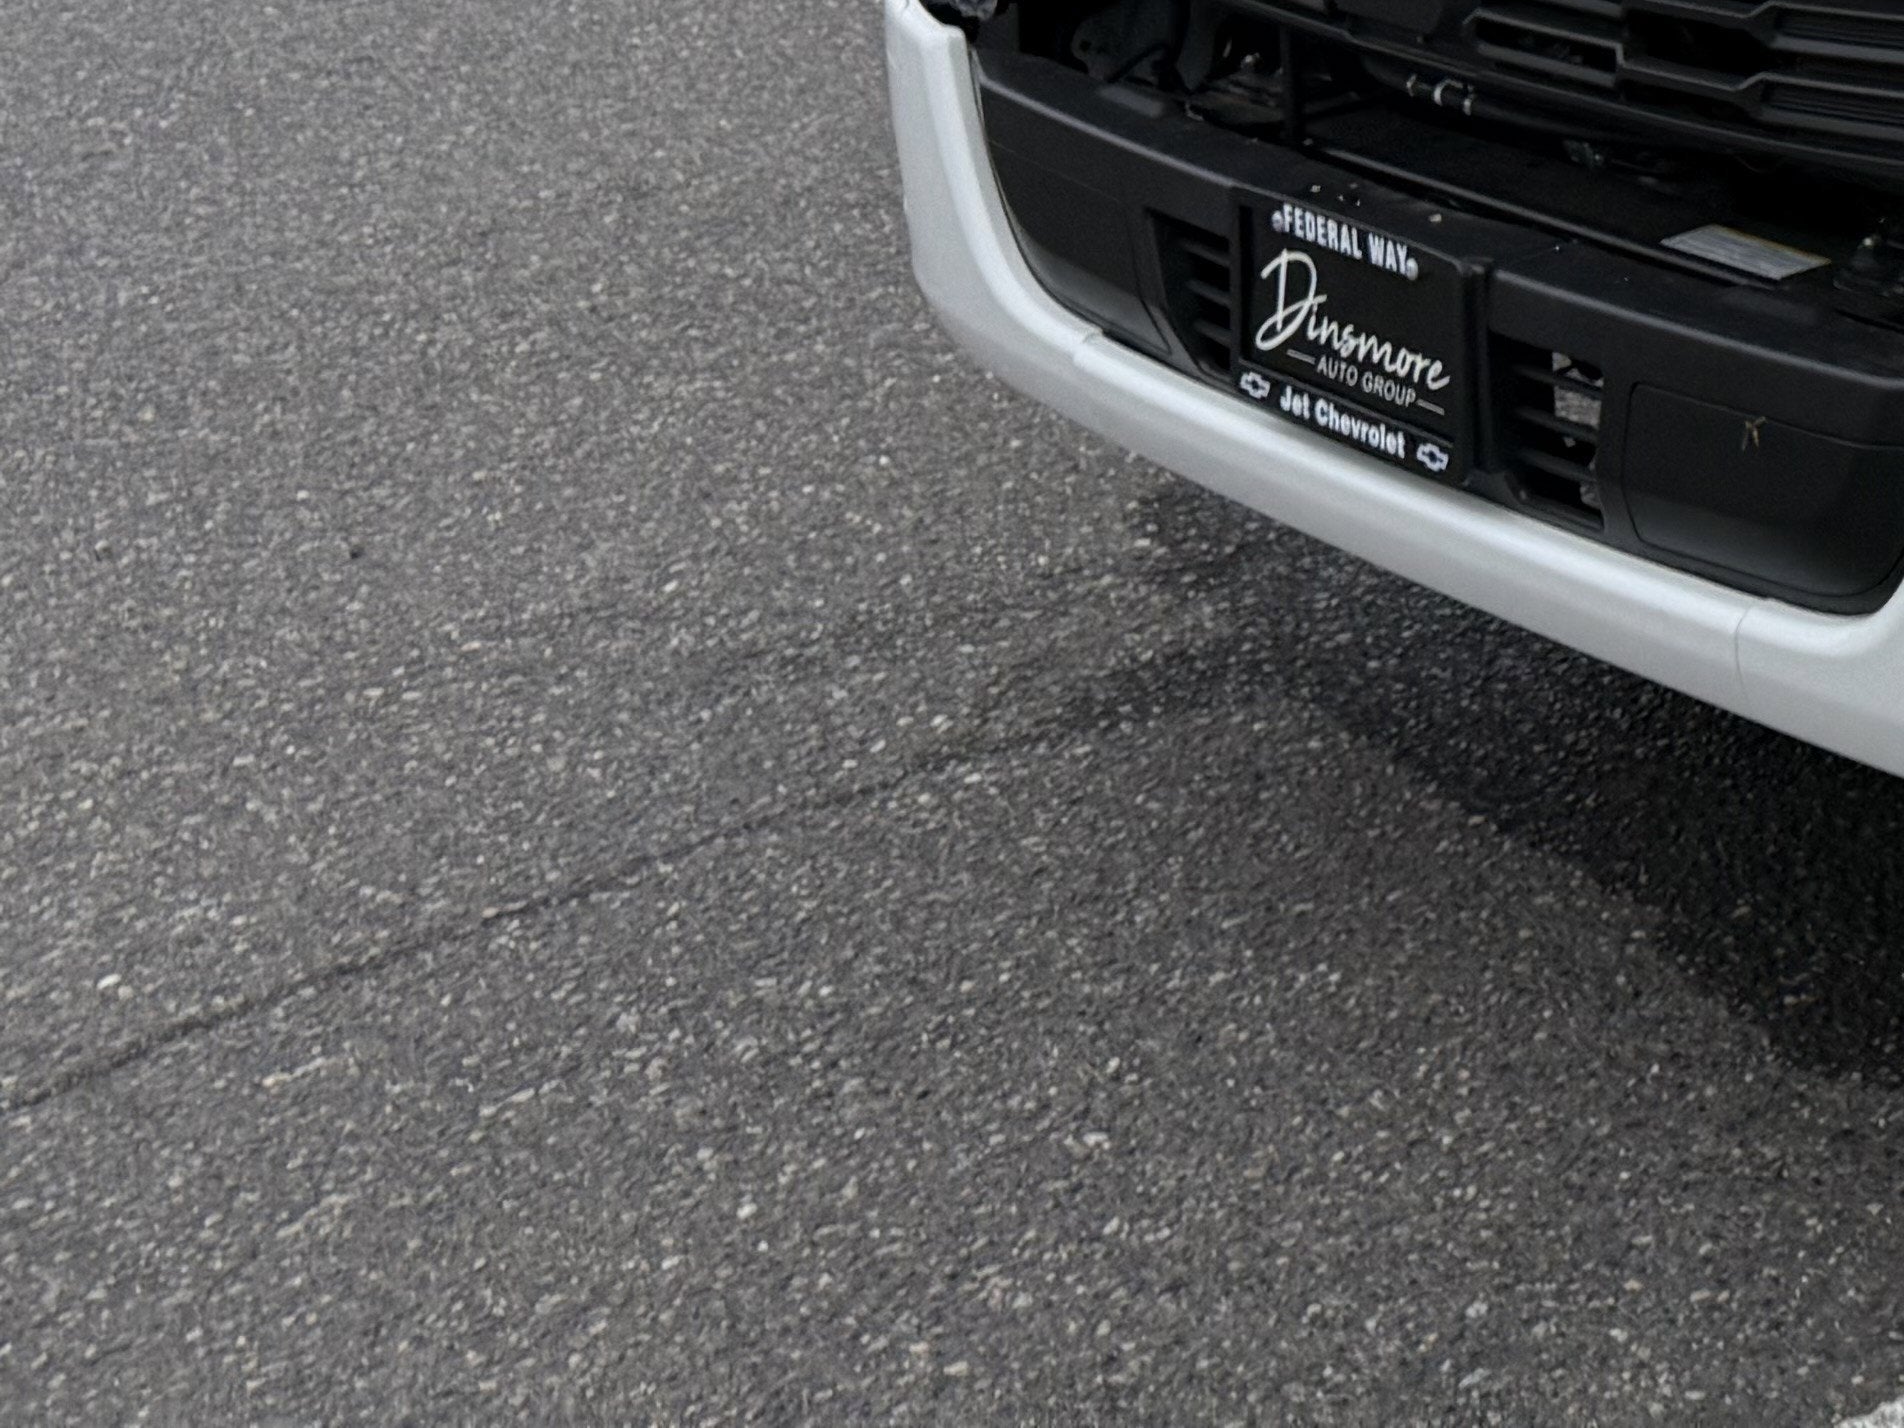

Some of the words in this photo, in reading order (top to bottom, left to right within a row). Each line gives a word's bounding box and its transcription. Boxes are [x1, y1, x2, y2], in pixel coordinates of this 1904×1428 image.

[1282, 202, 1363, 261] FEDERAL
[1367, 231, 1409, 278] WAY
[1255, 248, 1451, 391] Dinsmore
[1316, 355, 1359, 387] AUTO
[1361, 369, 1416, 408] GROUP
[1279, 385, 1311, 421] Jet
[1314, 398, 1406, 459] Chevrolet
